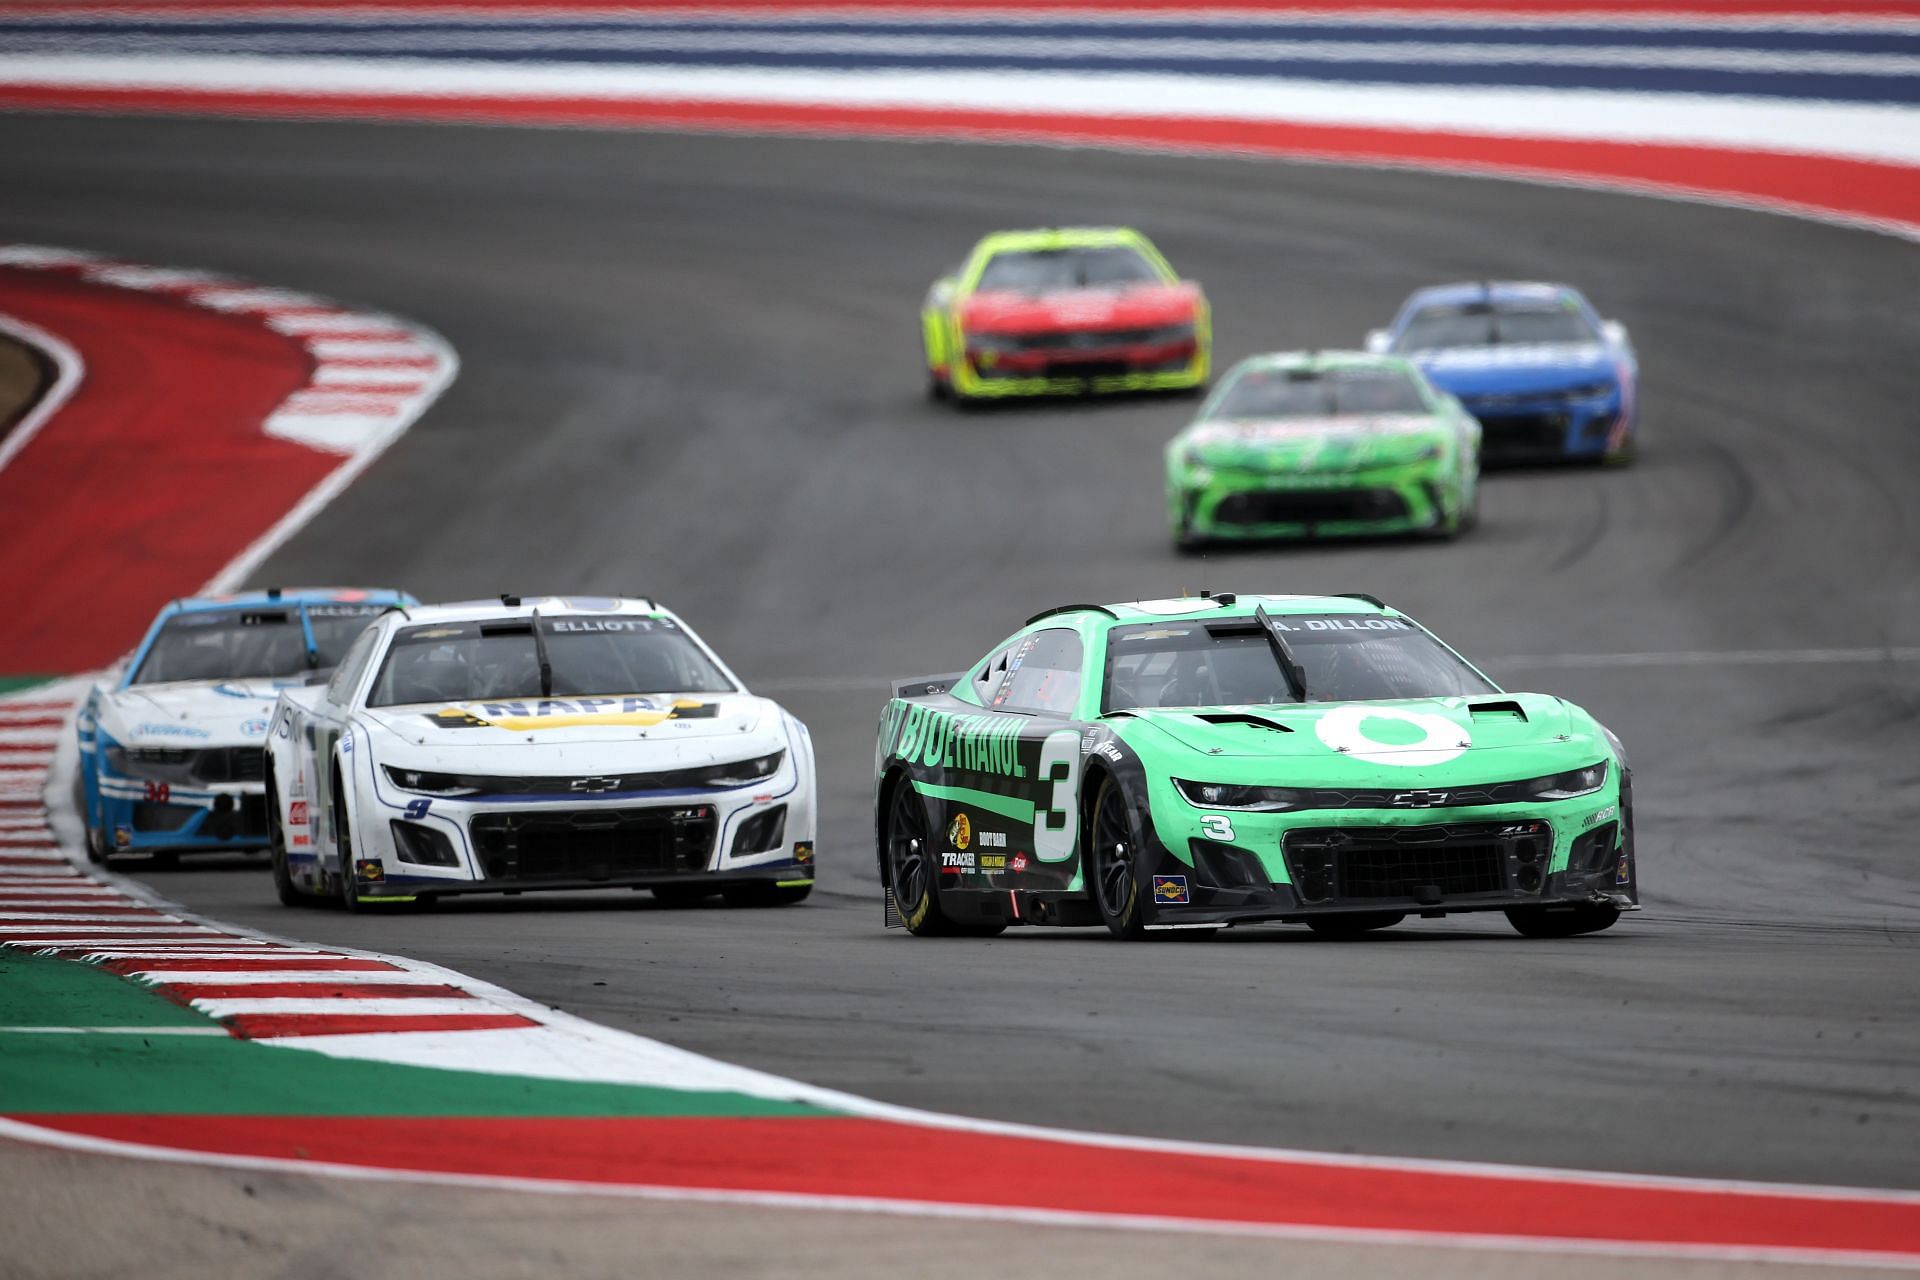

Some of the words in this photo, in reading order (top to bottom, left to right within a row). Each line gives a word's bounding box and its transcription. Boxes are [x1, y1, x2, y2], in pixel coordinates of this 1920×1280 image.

[552, 619, 655, 633] ELLIOTT
[1303, 618, 1410, 632] DILLON
[482, 697, 656, 717] NAPA
[1033, 728, 1083, 863] 3
[404, 799, 433, 819] 9
[1200, 814, 1236, 842] 3
[941, 852, 976, 866] TRACKER
[1157, 886, 1185, 895] SUNOCO
